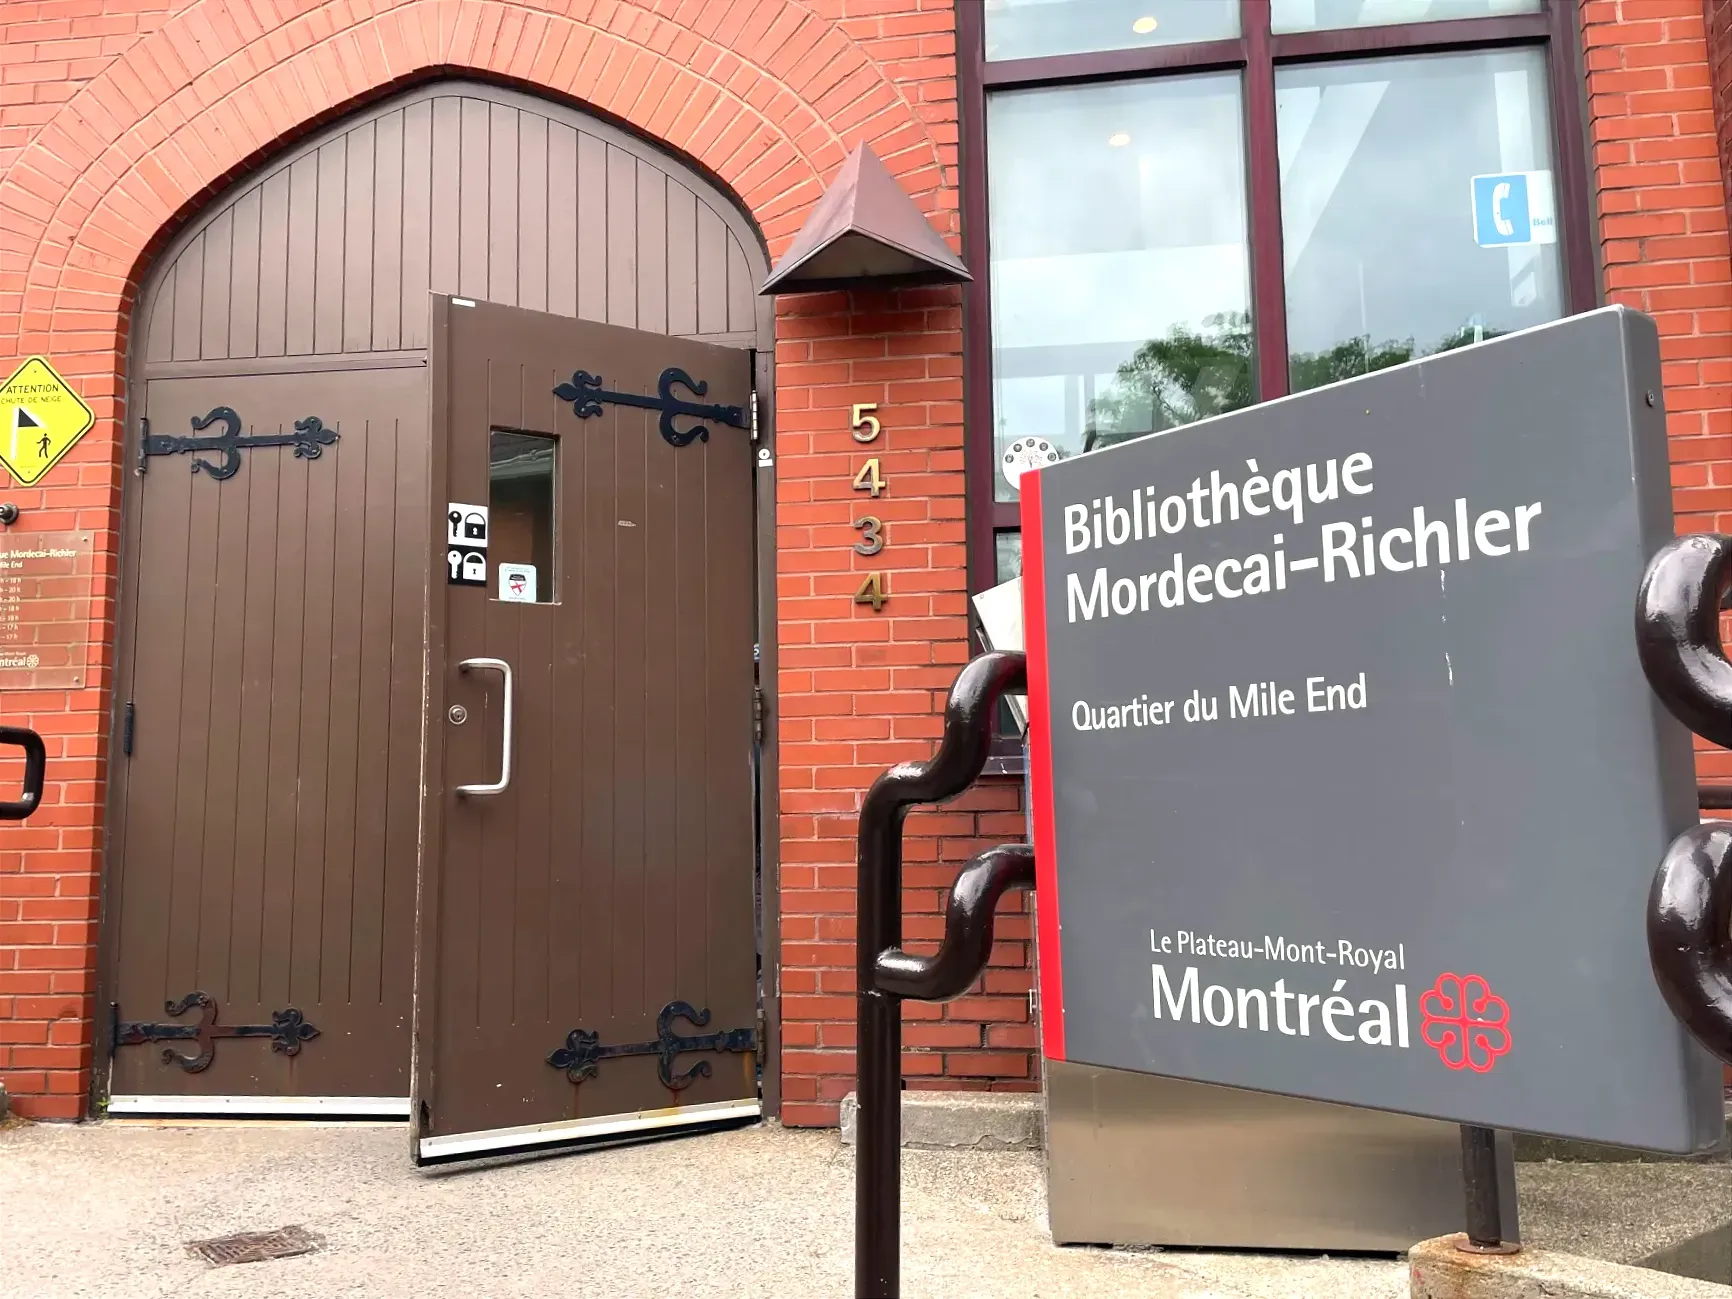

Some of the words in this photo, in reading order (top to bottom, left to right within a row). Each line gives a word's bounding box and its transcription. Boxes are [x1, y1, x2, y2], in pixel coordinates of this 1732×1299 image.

[1533, 216, 1552, 225] Bell
[6, 384, 59, 394] ATTENTION
[1064, 452, 1374, 555] Bibliothèque
[11, 560, 23, 569] End
[1066, 498, 1542, 624] Mordecai-Richler
[1070, 691, 1175, 731] Quartier
[1183, 689, 1218, 723] du
[1229, 683, 1296, 718] Mile
[1306, 672, 1367, 713] End
[1150, 928, 1172, 954] Le
[1177, 930, 1405, 974] Plateau-Mont-Royal
[1151, 963, 1410, 1048] Montréal
